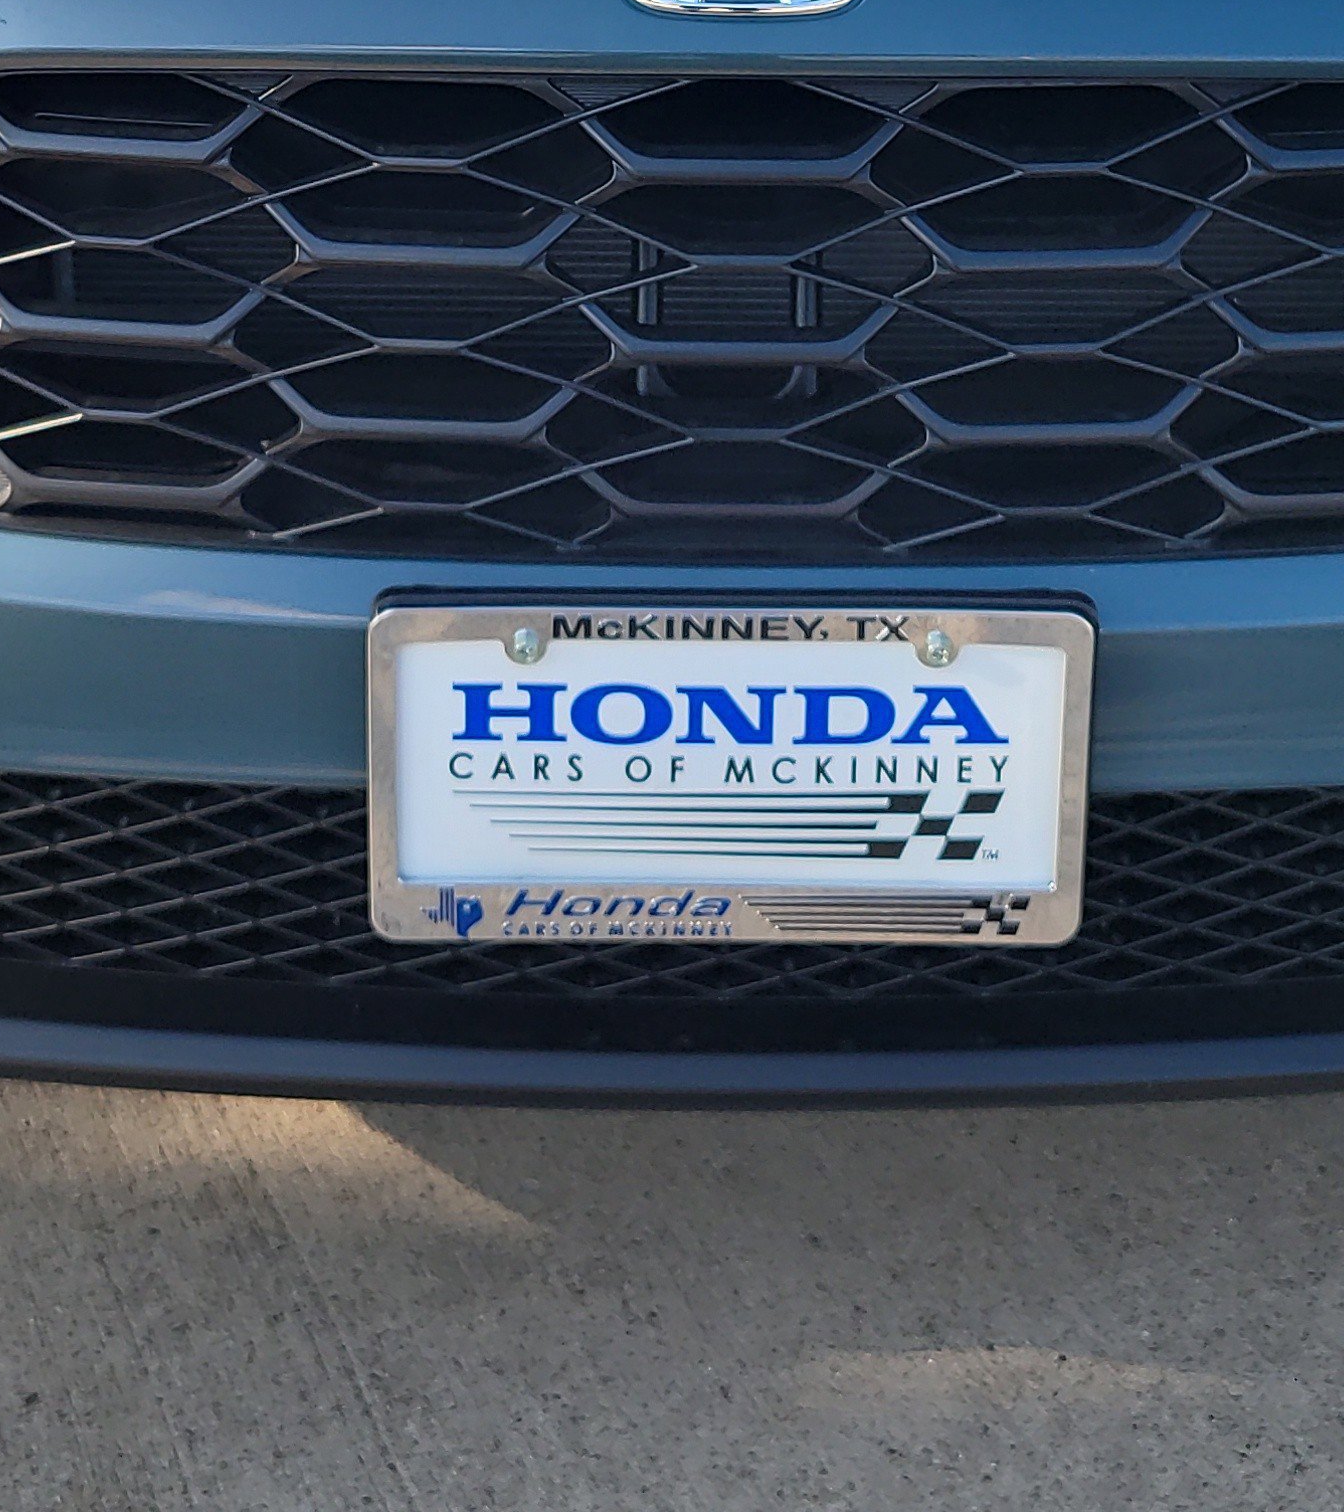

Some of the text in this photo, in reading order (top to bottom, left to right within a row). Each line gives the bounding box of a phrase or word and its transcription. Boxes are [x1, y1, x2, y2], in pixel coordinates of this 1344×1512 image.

[846, 616, 910, 642] TX
[452, 683, 1010, 745] HONDA
[449, 752, 1009, 785] CARS OF MCKINNEY
[506, 889, 732, 917] Honda
[503, 921, 560, 936] CARS
[570, 922, 598, 936] OF
